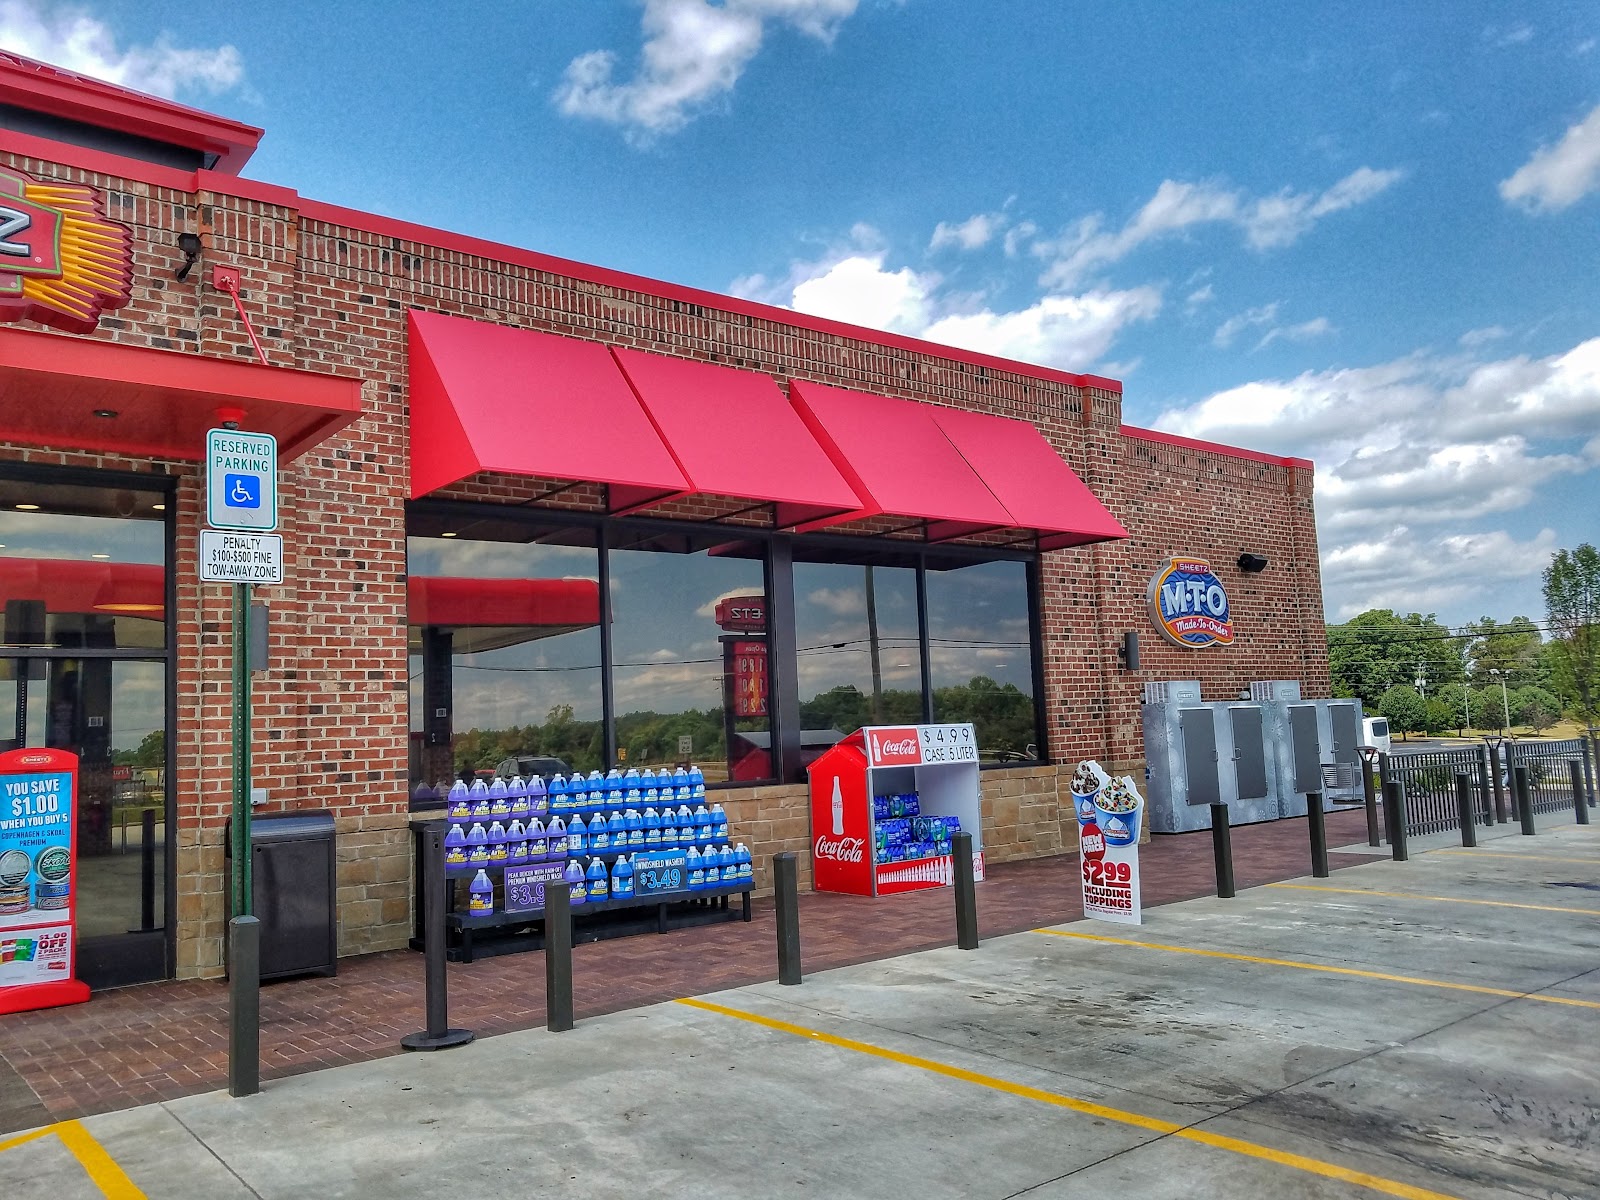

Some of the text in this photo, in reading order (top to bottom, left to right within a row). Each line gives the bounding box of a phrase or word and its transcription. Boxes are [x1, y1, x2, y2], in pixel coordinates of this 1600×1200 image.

[213, 438, 271, 456] RESERVED
[216, 456, 269, 472] PARKING
[223, 536, 261, 551] PENALTY
[212, 548, 272, 564] $100-$500 FINE
[207, 563, 277, 579] TOW-AWAY ZONE
[1179, 563, 1209, 573] SHEETZ
[882, 738, 917, 756] Coca-Cola
[924, 748, 945, 762] CASE
[956, 746, 975, 760] LITER
[6, 778, 60, 797] YOU SAVE
[12, 793, 59, 817] $1.00
[0, 813, 68, 830] WHEN YOU BUY 5
[1, 831, 40, 840] COPENHAGEN
[47, 829, 66, 837] SKOAL
[19, 838, 47, 847] PREMIUM
[1082, 833, 1102, 846] NEW
[814, 835, 865, 863] Coca-Cola
[1083, 843, 1105, 854] PRICE
[508, 871, 519, 879] PEAK
[508, 872, 562, 886] PREMIUM WINDSHIELD WASH
[640, 868, 681, 889] $3.49
[510, 882, 545, 905] $3.9
[1084, 885, 1132, 899] INCLUDING
[1084, 894, 1132, 909] TOPPINGS
[38, 938, 68, 949] OFF
